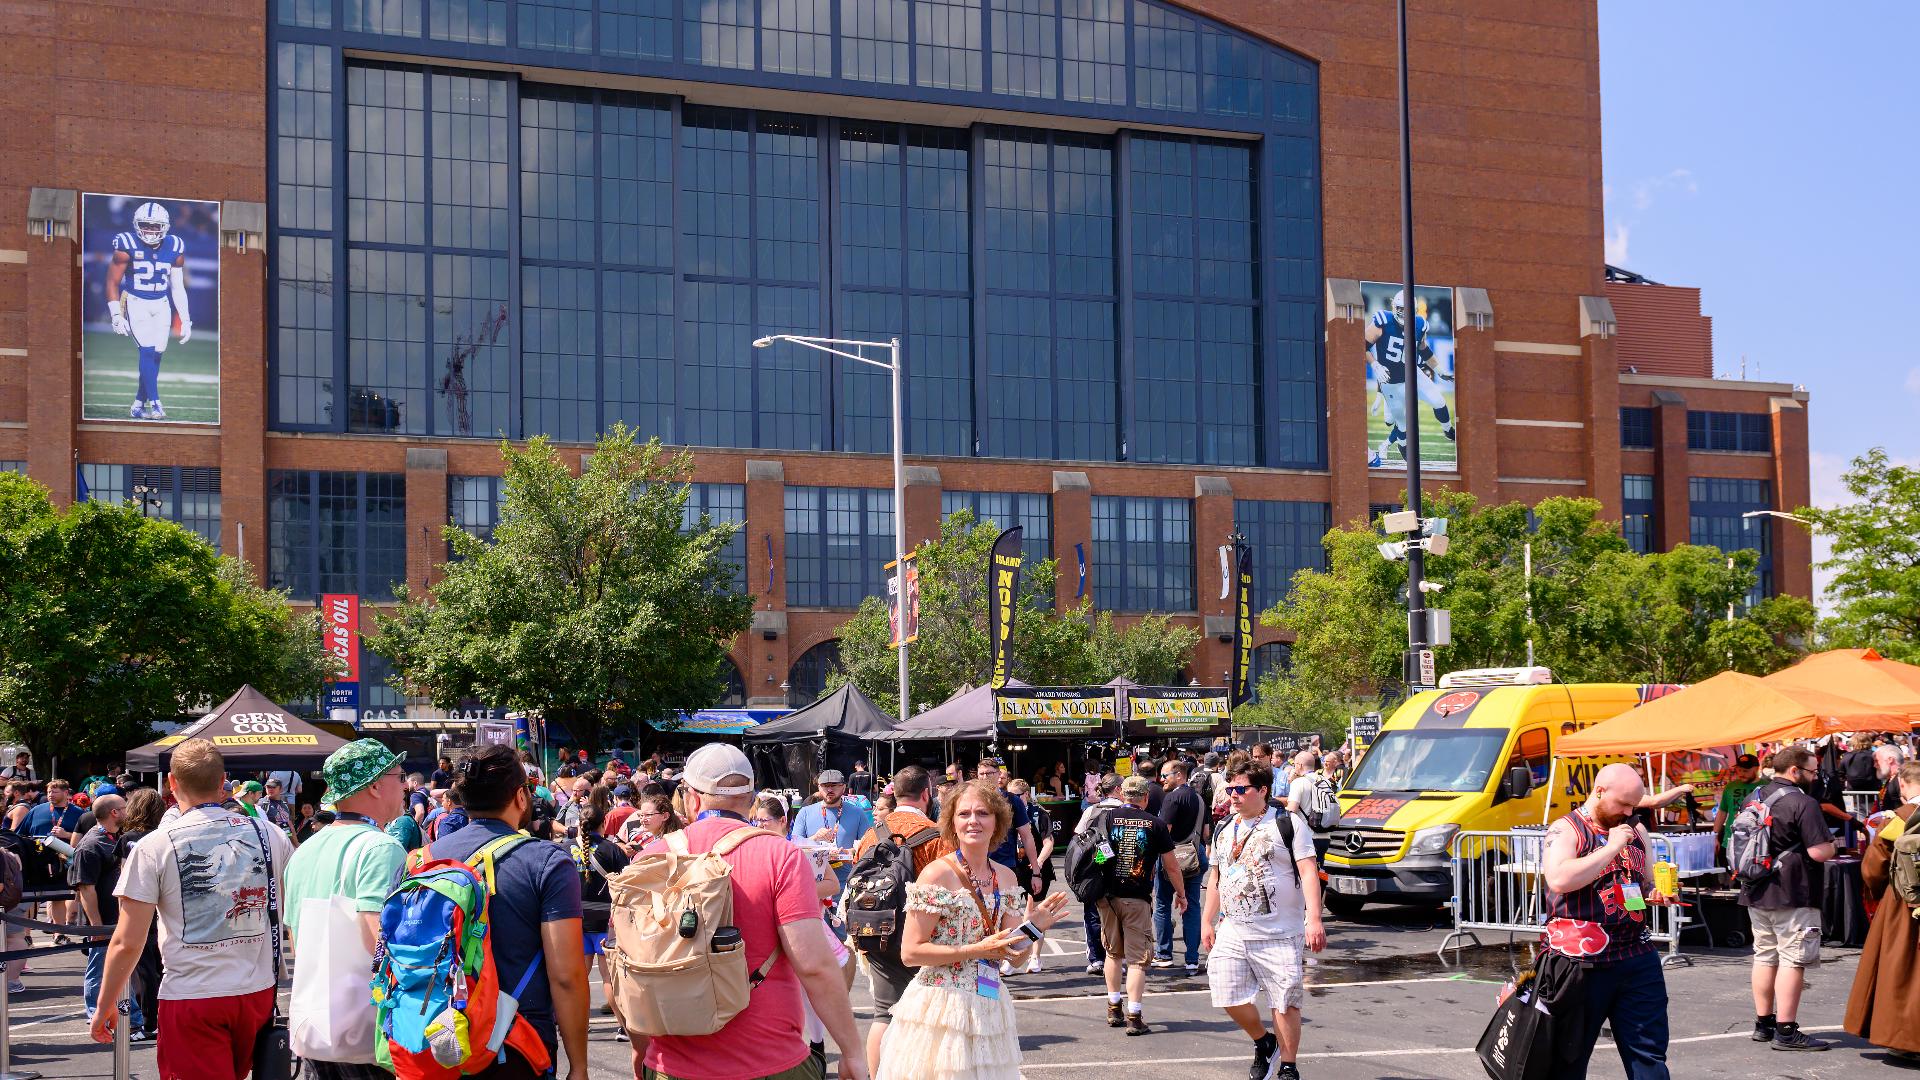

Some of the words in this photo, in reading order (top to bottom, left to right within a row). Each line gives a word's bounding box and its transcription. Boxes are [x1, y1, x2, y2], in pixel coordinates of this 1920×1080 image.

[133, 260, 172, 292] 23
[1385, 335, 1405, 363] 5
[995, 554, 1021, 568] ISLAND
[332, 598, 349, 624] OIL
[1002, 702, 1044, 715] ISLAND
[1061, 701, 1112, 715] NOODLES
[1134, 702, 1170, 714] ISLAND
[1183, 701, 1225, 714] NOODLES
[230, 712, 284, 724] GEN
[450, 709, 495, 720] GATE
[233, 723, 288, 734] CON
[219, 736, 266, 744] BLOCK
[270, 735, 313, 743] PARTY
[487, 731, 506, 739] BUY
[1356, 798, 1408, 808] SUN
[1347, 806, 1396, 815] KING
[269, 877, 277, 899] COOL
[270, 900, 278, 910] BE
